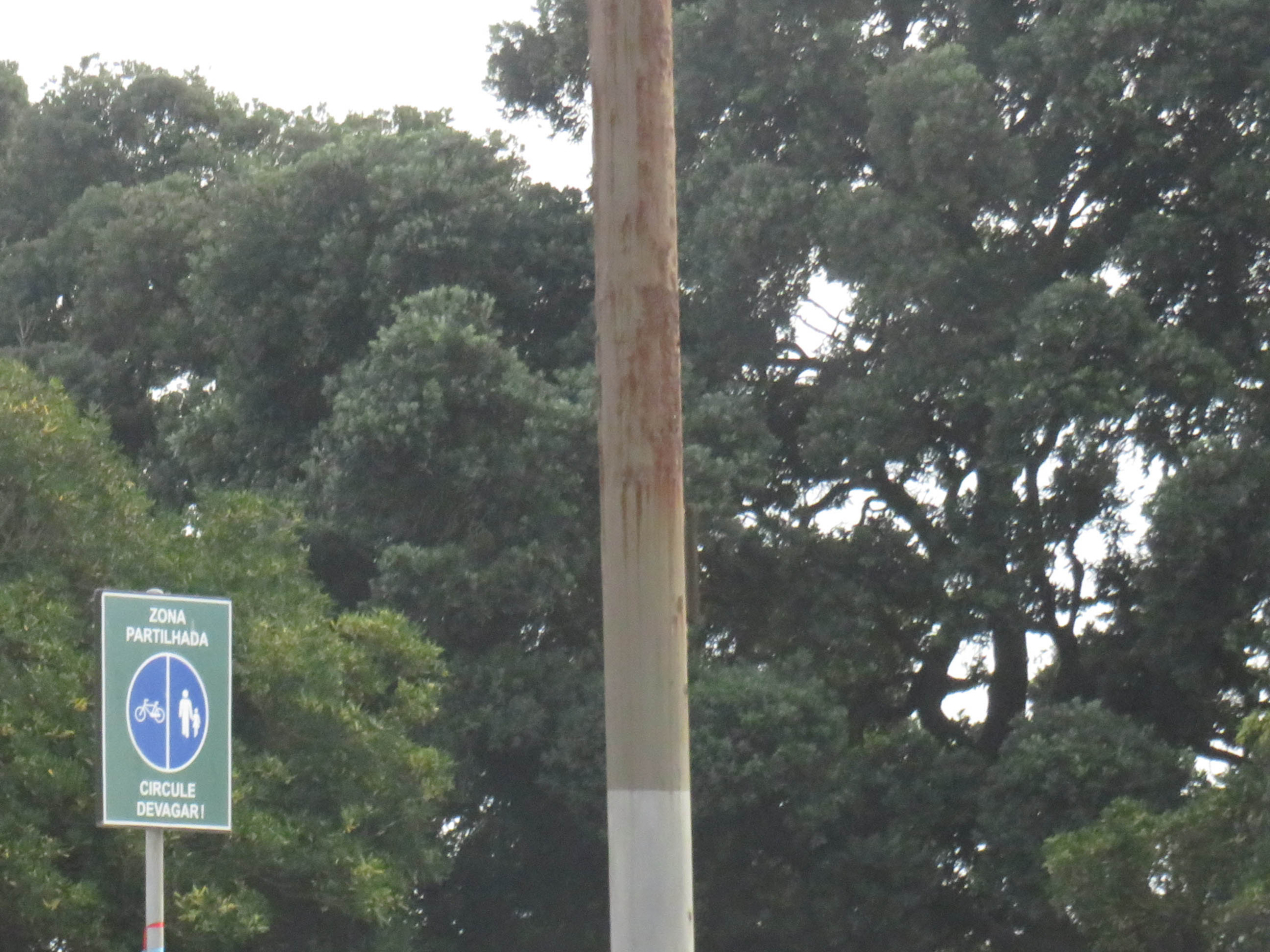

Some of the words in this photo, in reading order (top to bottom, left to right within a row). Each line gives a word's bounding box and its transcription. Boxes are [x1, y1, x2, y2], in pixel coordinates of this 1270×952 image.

[148, 607, 187, 625] ZONA
[126, 626, 209, 647] PARTILHADA
[139, 780, 196, 799] CIRCULE
[136, 801, 205, 819] DEVAGAR!
